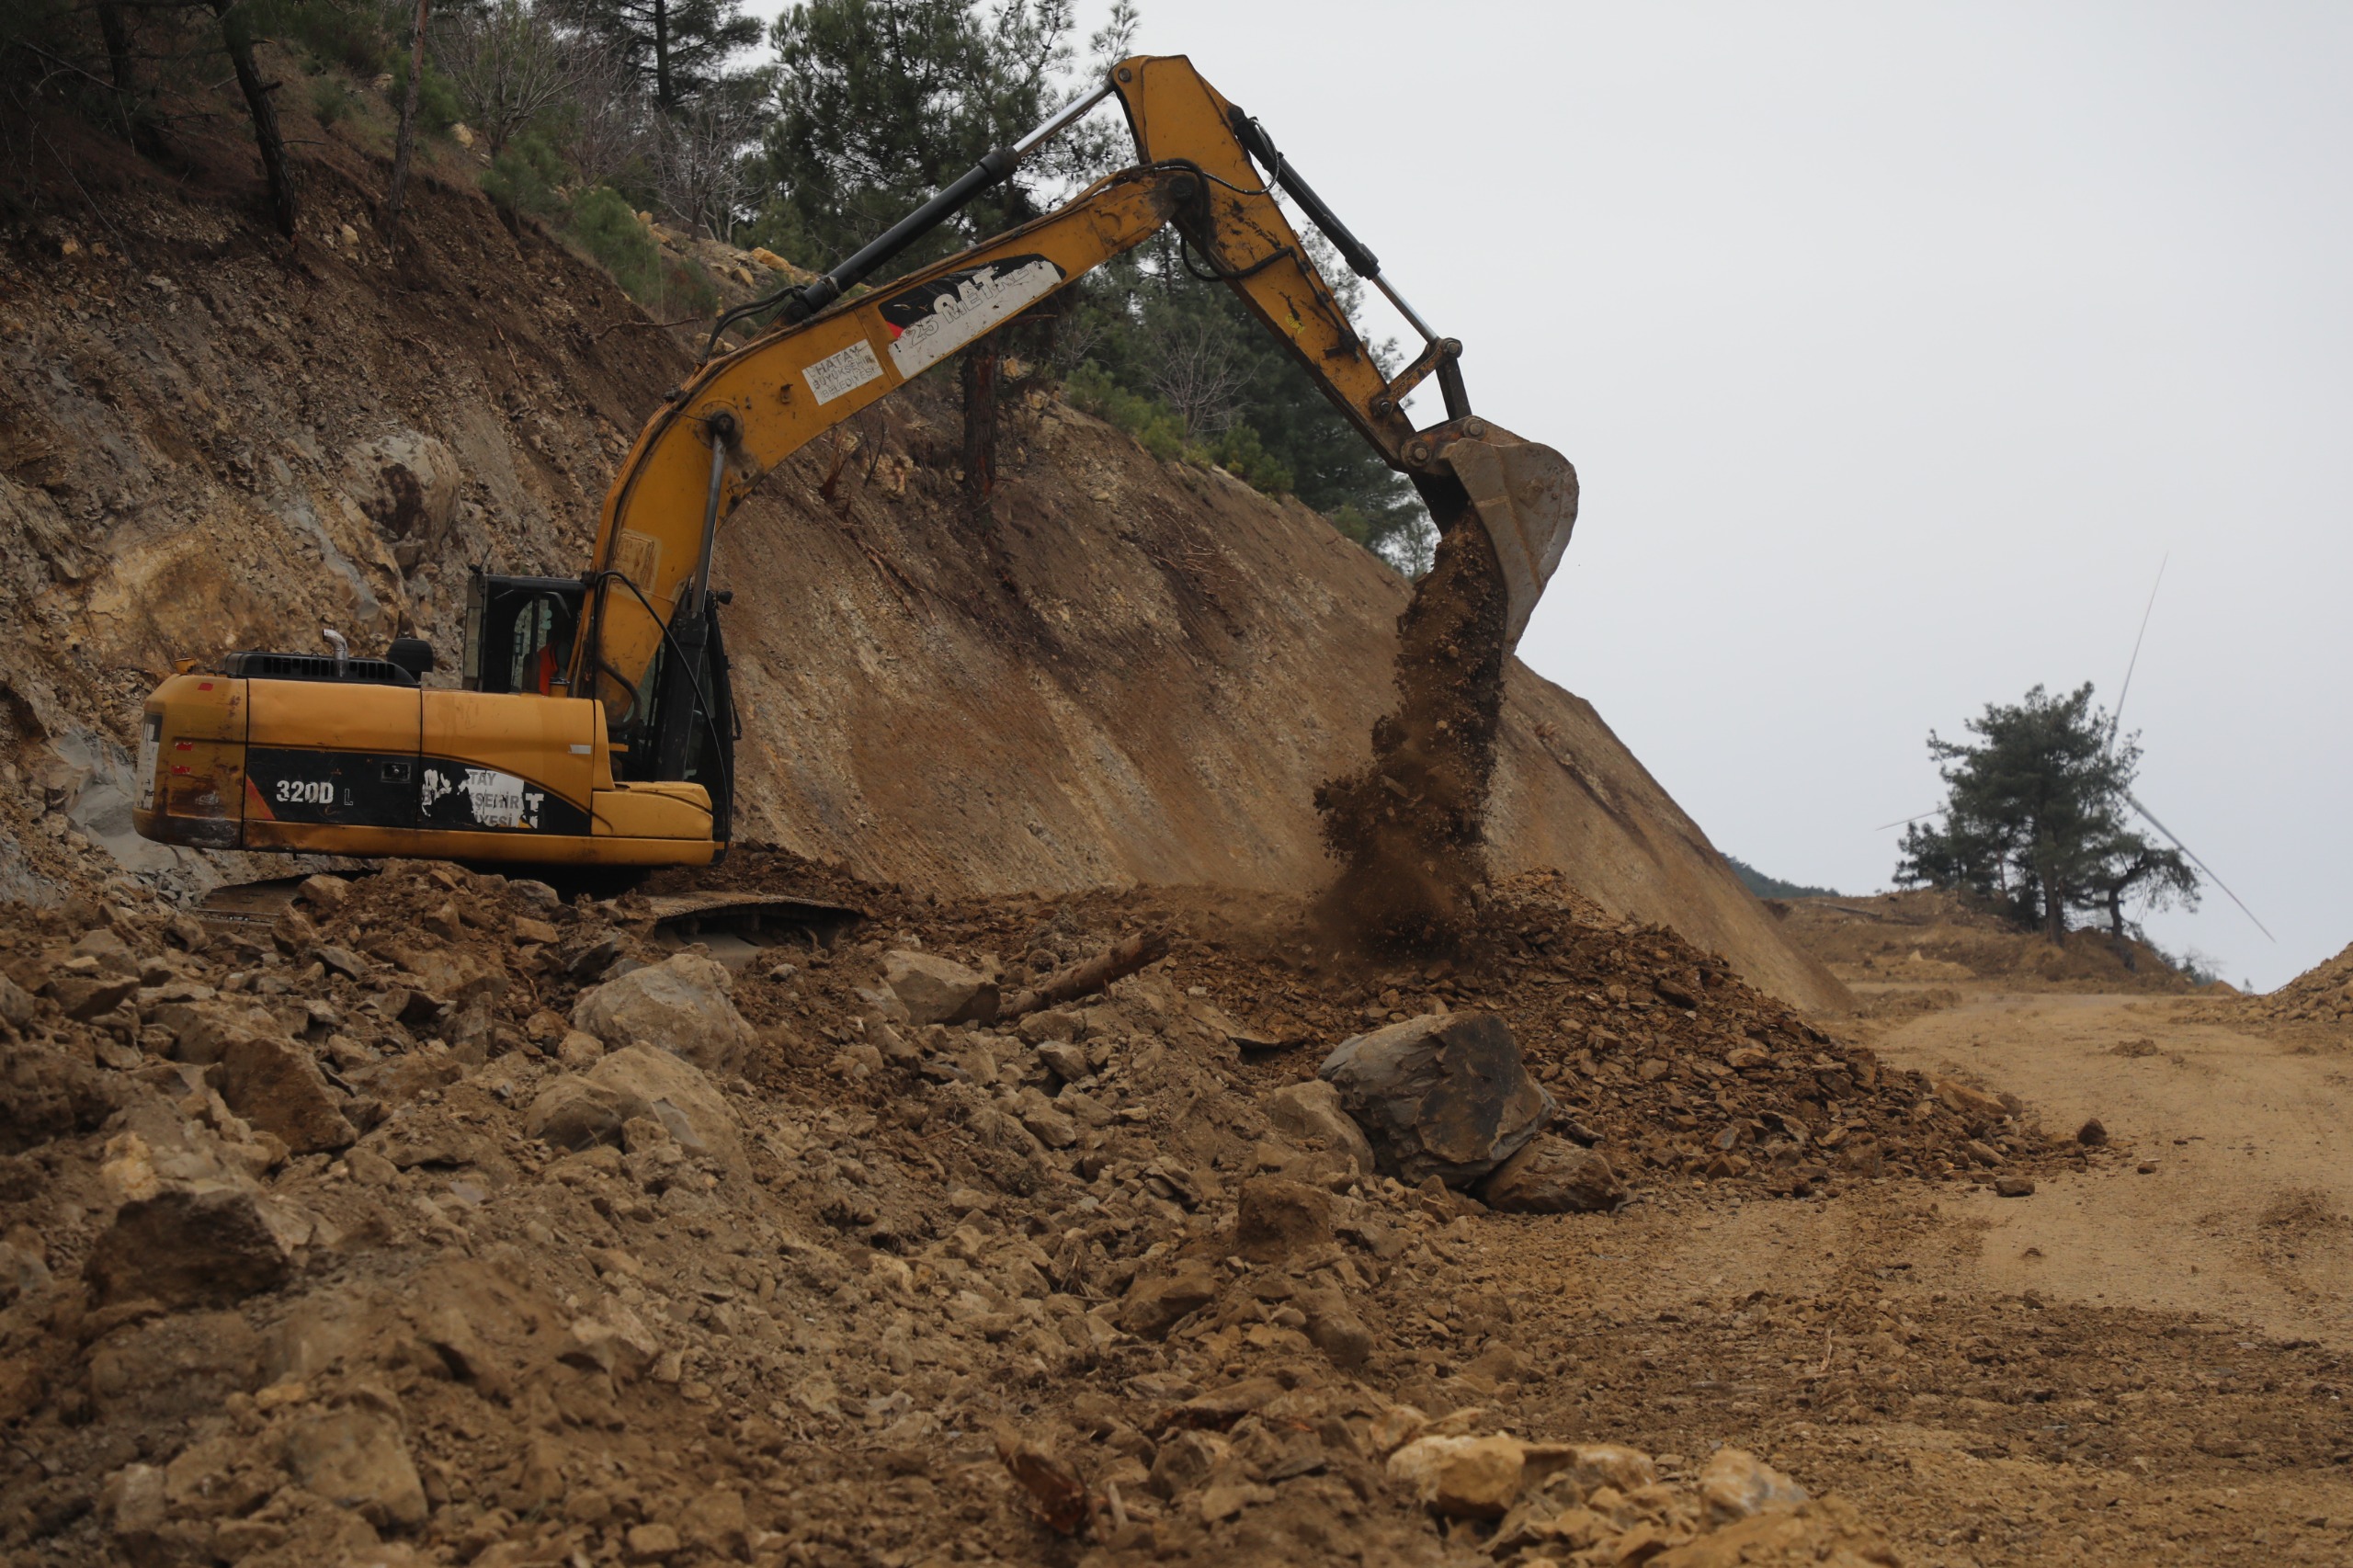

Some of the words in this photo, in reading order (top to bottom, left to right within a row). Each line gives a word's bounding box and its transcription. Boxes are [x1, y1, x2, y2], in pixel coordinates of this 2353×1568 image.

[910, 315, 939, 347] 25
[814, 346, 861, 375] HATAY
[277, 780, 334, 804] 320D
[344, 789, 354, 805] L
